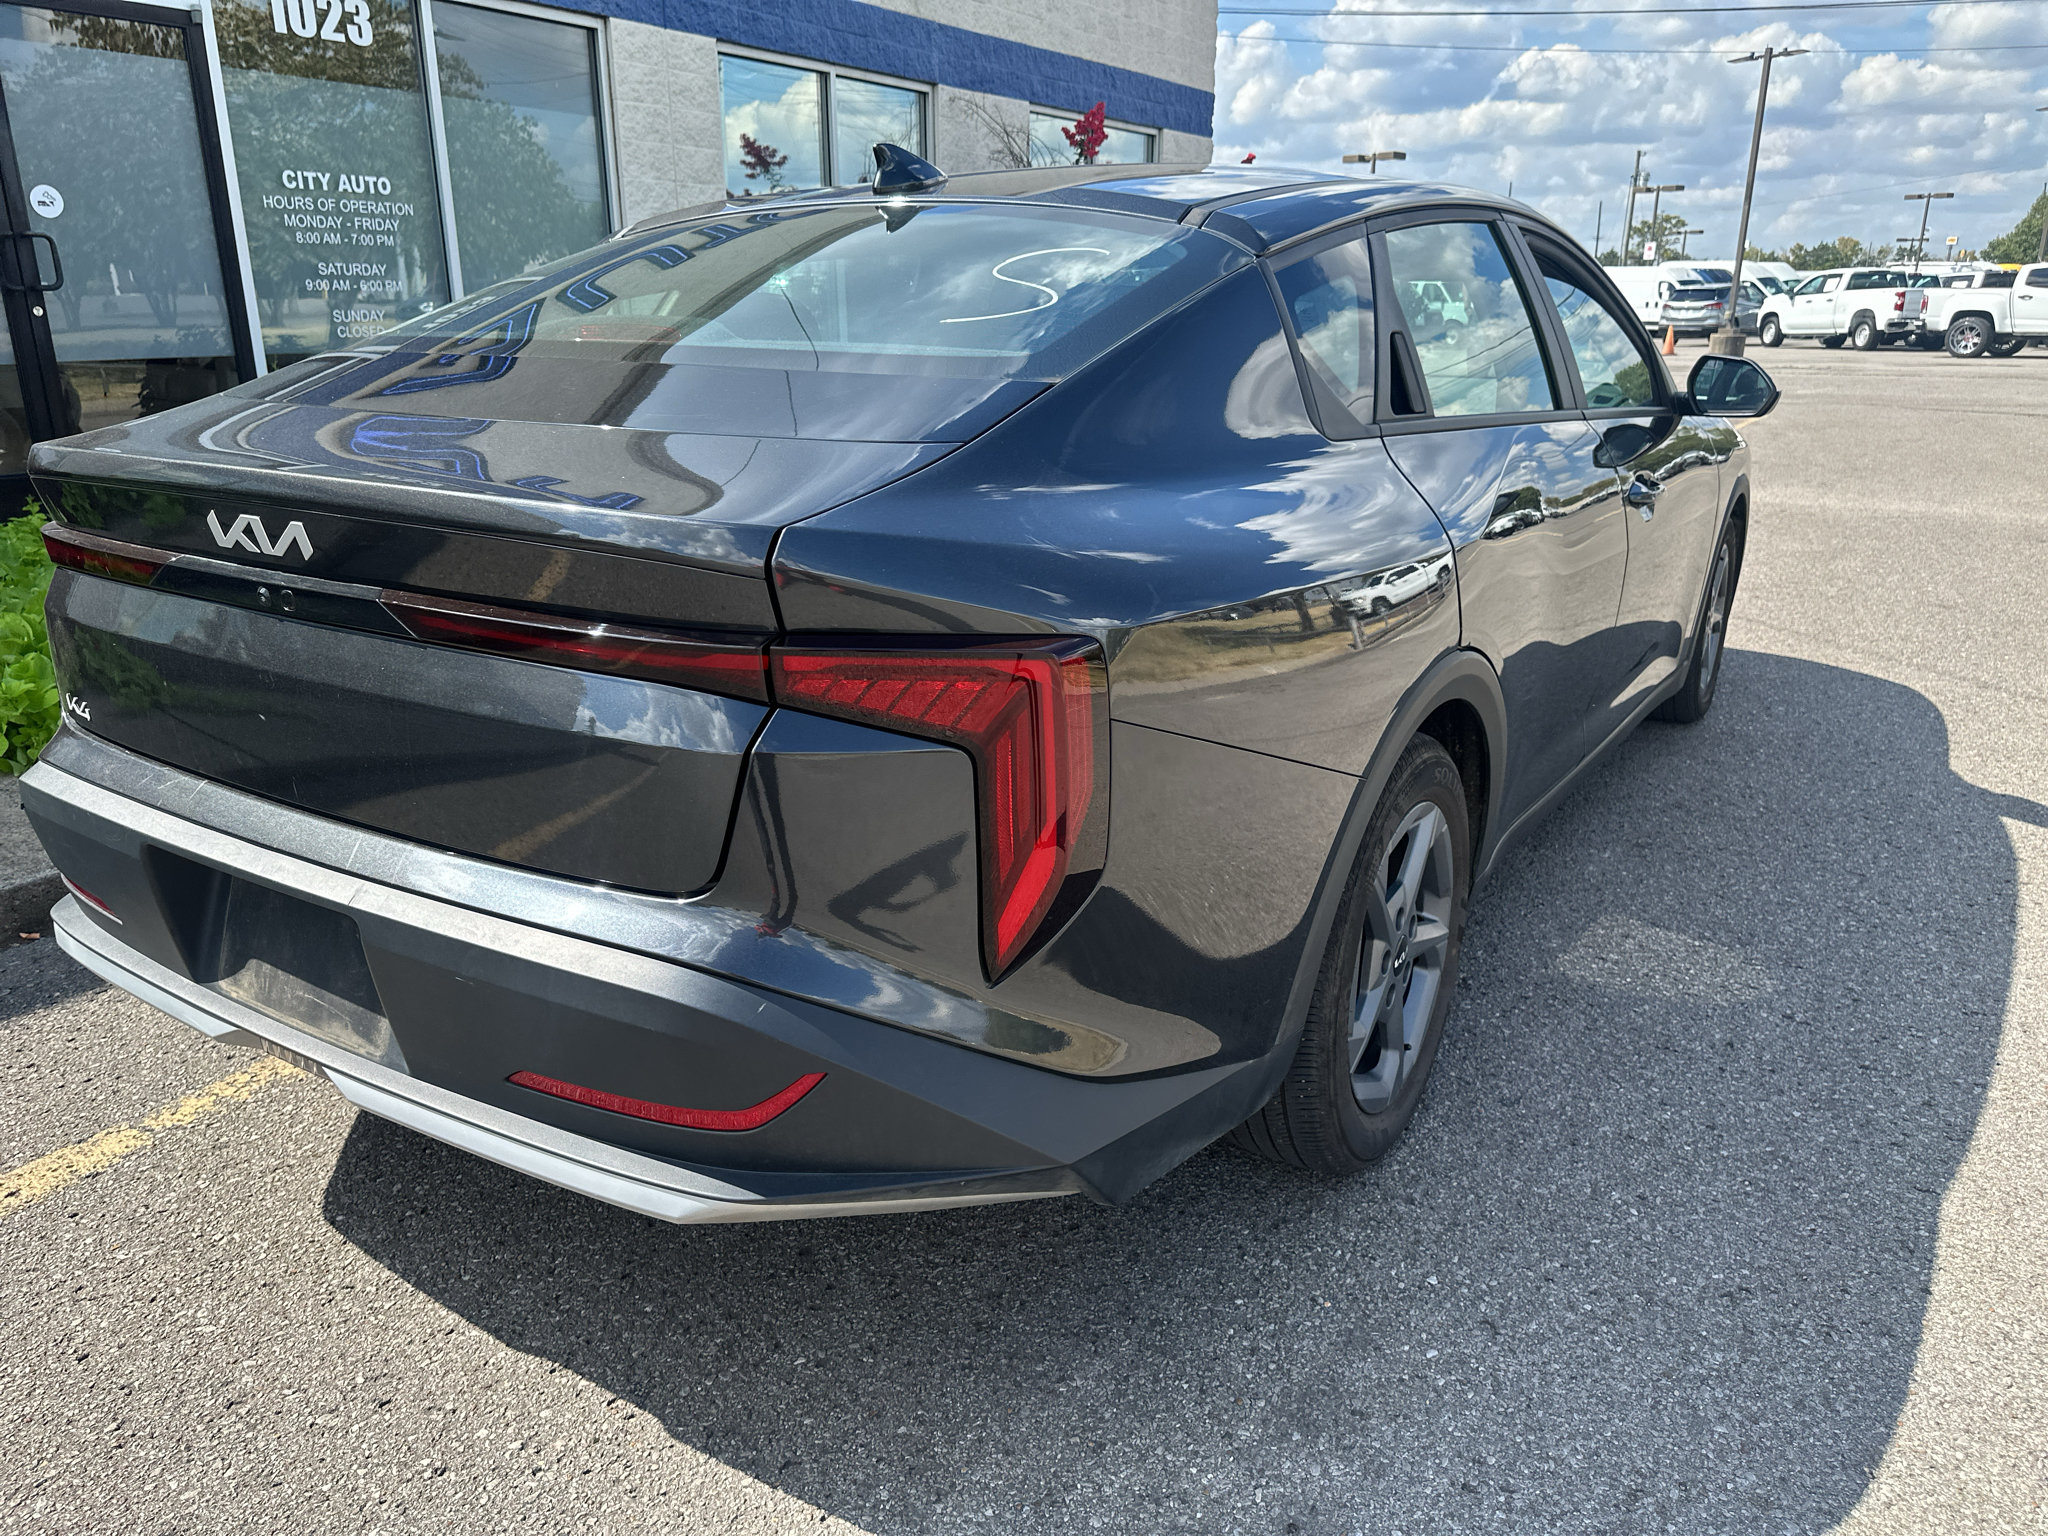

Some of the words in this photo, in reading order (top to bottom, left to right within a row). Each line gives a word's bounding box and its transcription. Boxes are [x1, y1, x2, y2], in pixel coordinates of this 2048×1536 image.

[271, 0, 374, 47] 1023
[282, 170, 331, 191] CITY
[338, 174, 391, 195] AUTO
[262, 195, 314, 211] HOURS
[317, 197, 336, 212] OF
[339, 199, 414, 217] OPERATION
[284, 213, 343, 229] MONDAY
[354, 217, 400, 232] FRIDAY
[295, 231, 321, 245] 8:00
[322, 232, 342, 245] AM
[351, 233, 375, 247] 7:00
[376, 234, 395, 247] PM
[318, 262, 387, 277] SATURDAY
[305, 279, 330, 292] 9:00
[332, 279, 351, 292] AM
[359, 280, 383, 293] 6:00
[385, 280, 403, 293] PM
[333, 309, 386, 323] SUNDAY
[337, 325, 385, 338] CLOSED
[206, 509, 314, 561] KIA
[65, 692, 91, 722] K4
